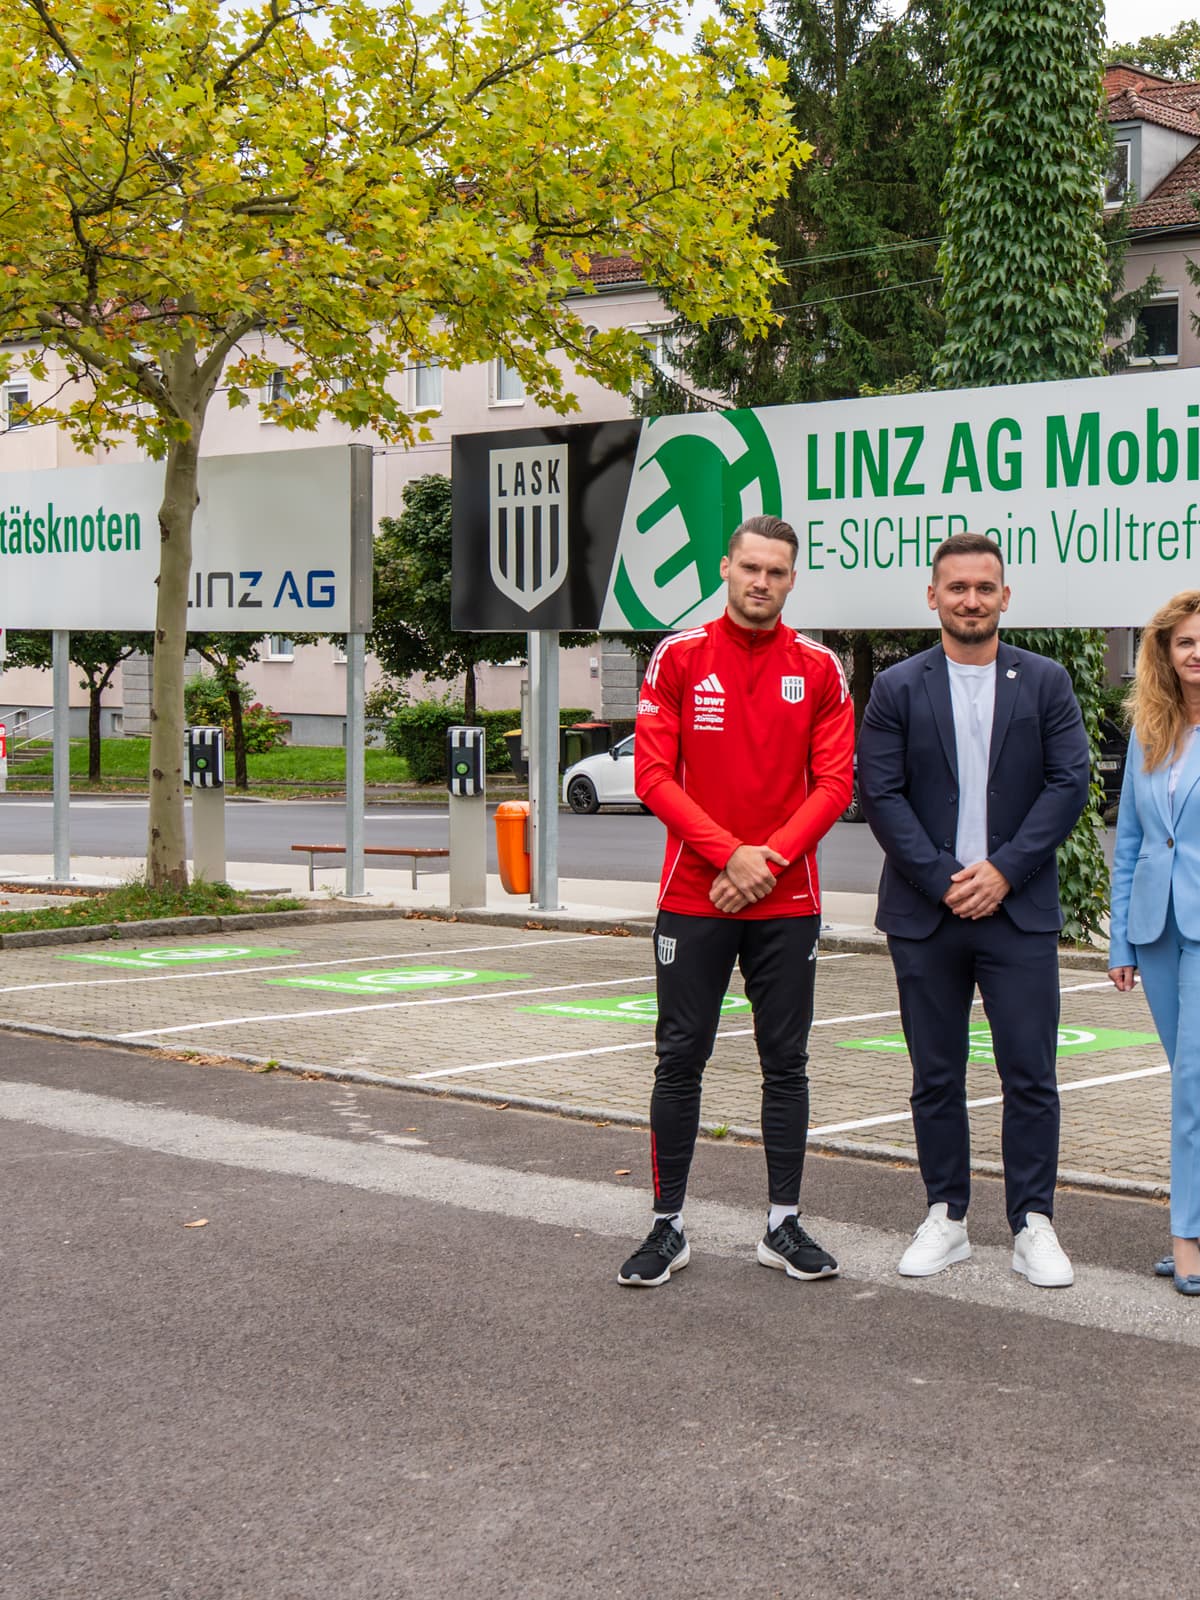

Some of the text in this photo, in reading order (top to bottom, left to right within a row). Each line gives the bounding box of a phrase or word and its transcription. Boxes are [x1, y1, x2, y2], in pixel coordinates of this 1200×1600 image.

[496, 459, 561, 498] LASK
[807, 426, 926, 502] LINZ
[942, 418, 1022, 495] AG
[188, 569, 336, 608] INZ AG
